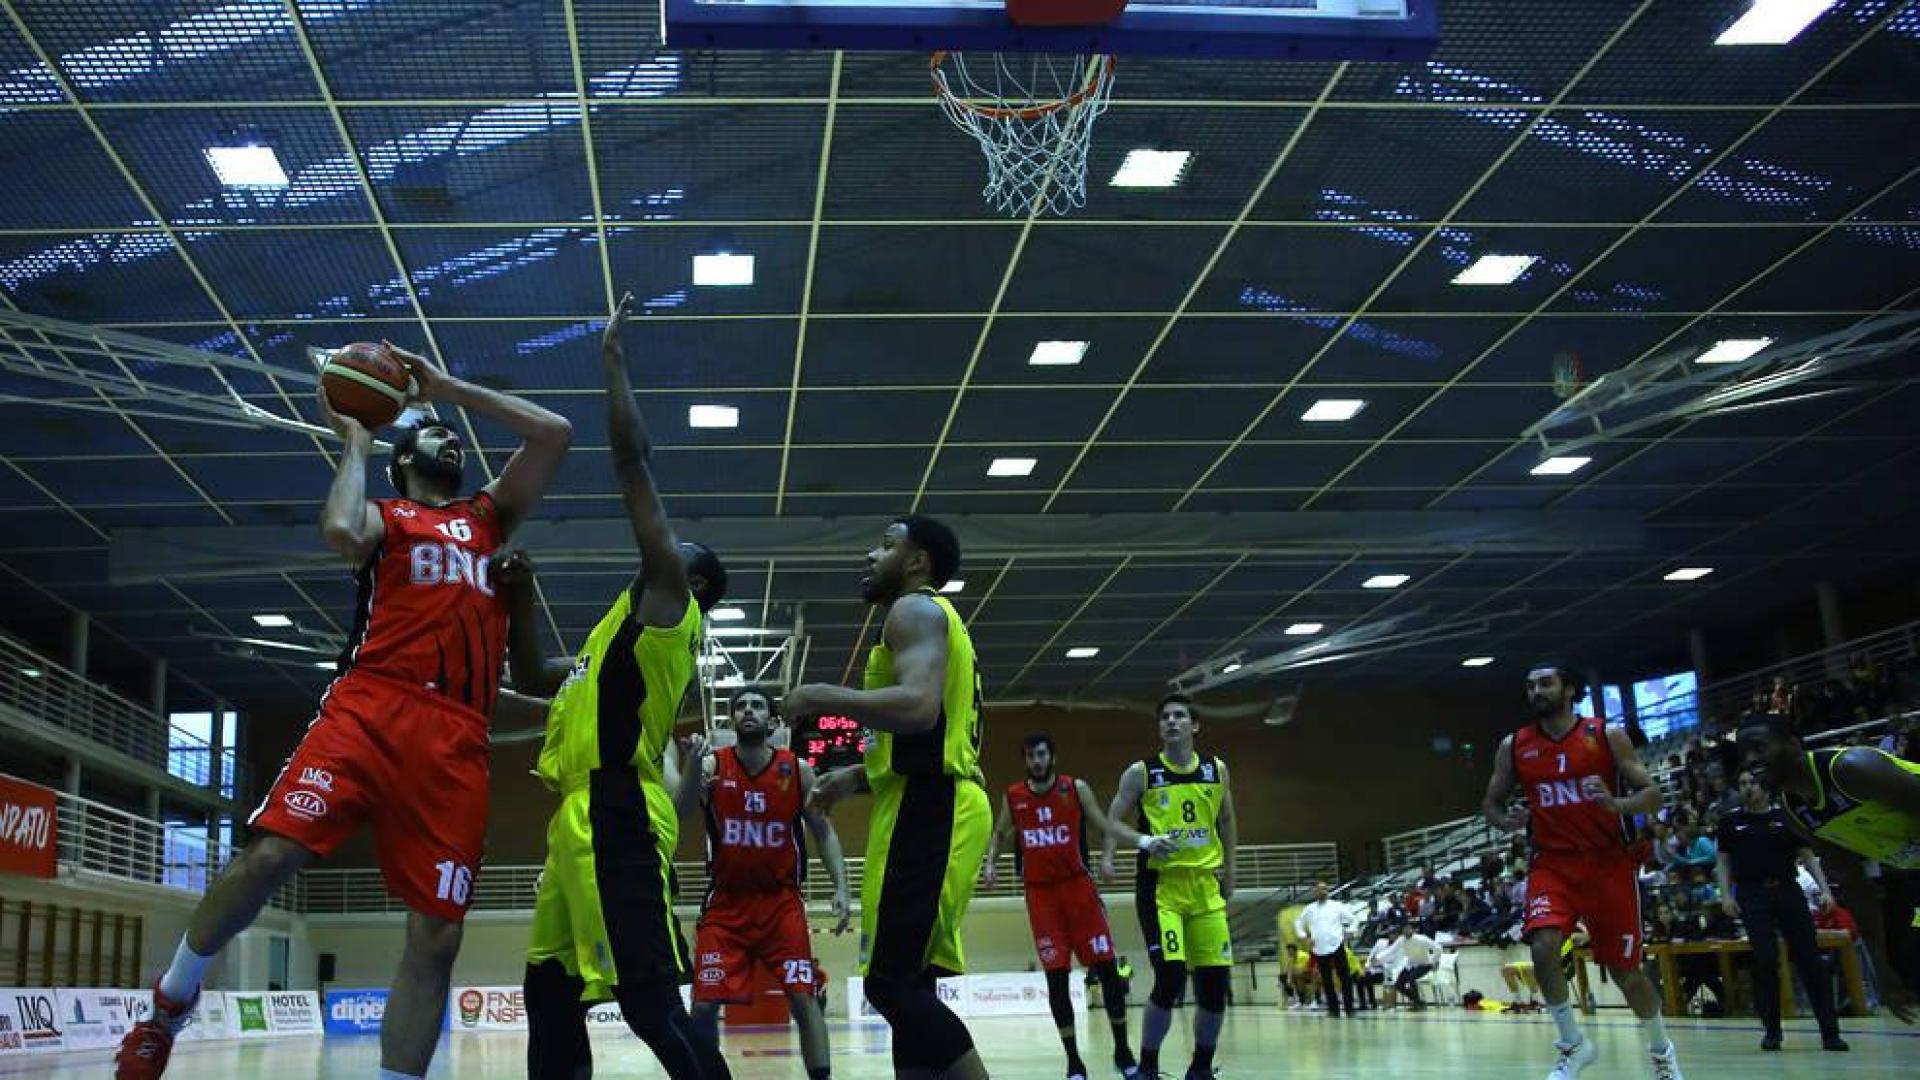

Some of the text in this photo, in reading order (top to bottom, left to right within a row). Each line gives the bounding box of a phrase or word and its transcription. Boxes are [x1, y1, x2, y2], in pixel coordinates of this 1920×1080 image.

[434, 518, 472, 541] 16
[744, 790, 766, 813] 25
[1182, 800, 1196, 823] 8
[723, 818, 786, 847] BNC
[1023, 825, 1070, 848] BNC
[435, 860, 473, 906] 16
[1165, 930, 1179, 953] 8
[783, 960, 813, 984] 25
[271, 994, 311, 1008] HOTEL
[15, 995, 63, 1037] IMQ
